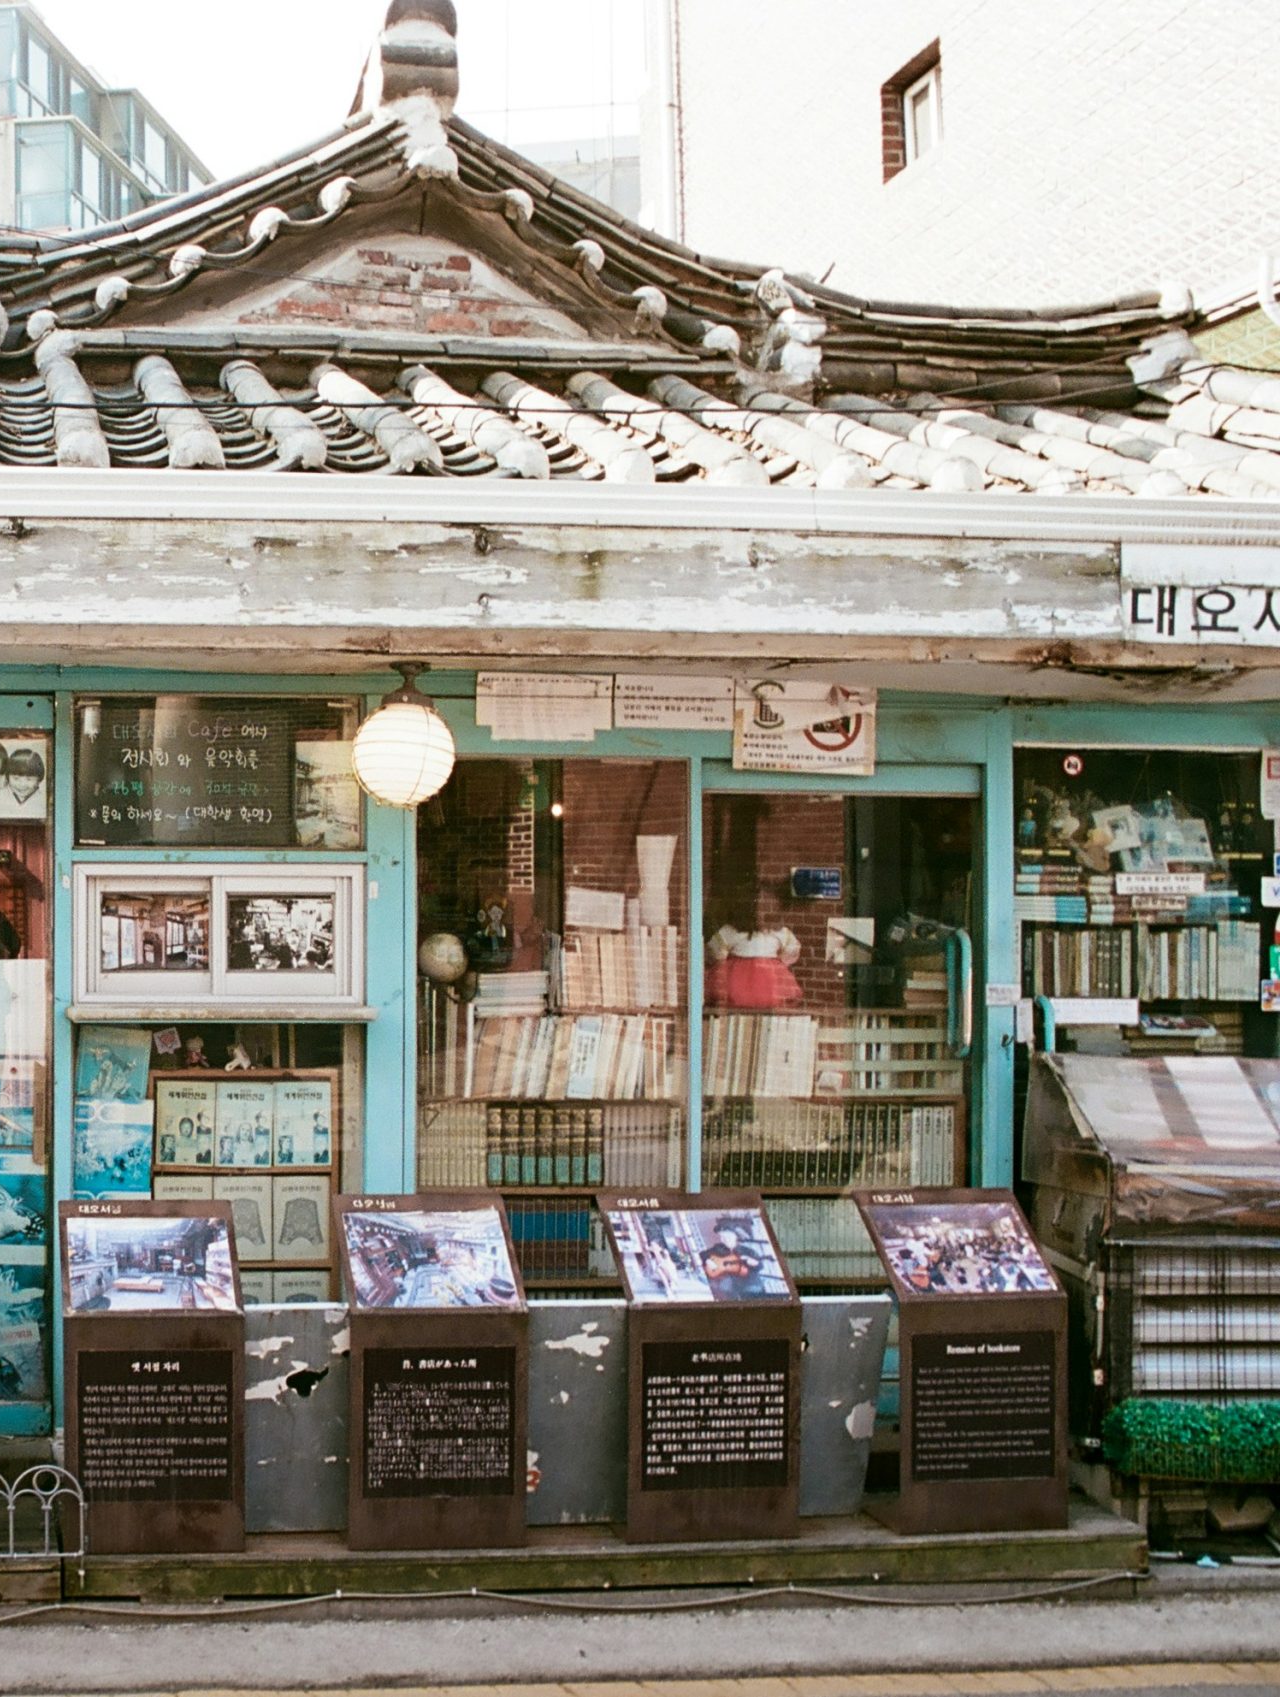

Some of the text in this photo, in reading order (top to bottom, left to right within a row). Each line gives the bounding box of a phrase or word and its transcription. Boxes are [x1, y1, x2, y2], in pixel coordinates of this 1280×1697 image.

[241, 724, 267, 739] 에서
[122, 747, 258, 769] 전시회 와 음악회를
[102, 805, 121, 824] 문의
